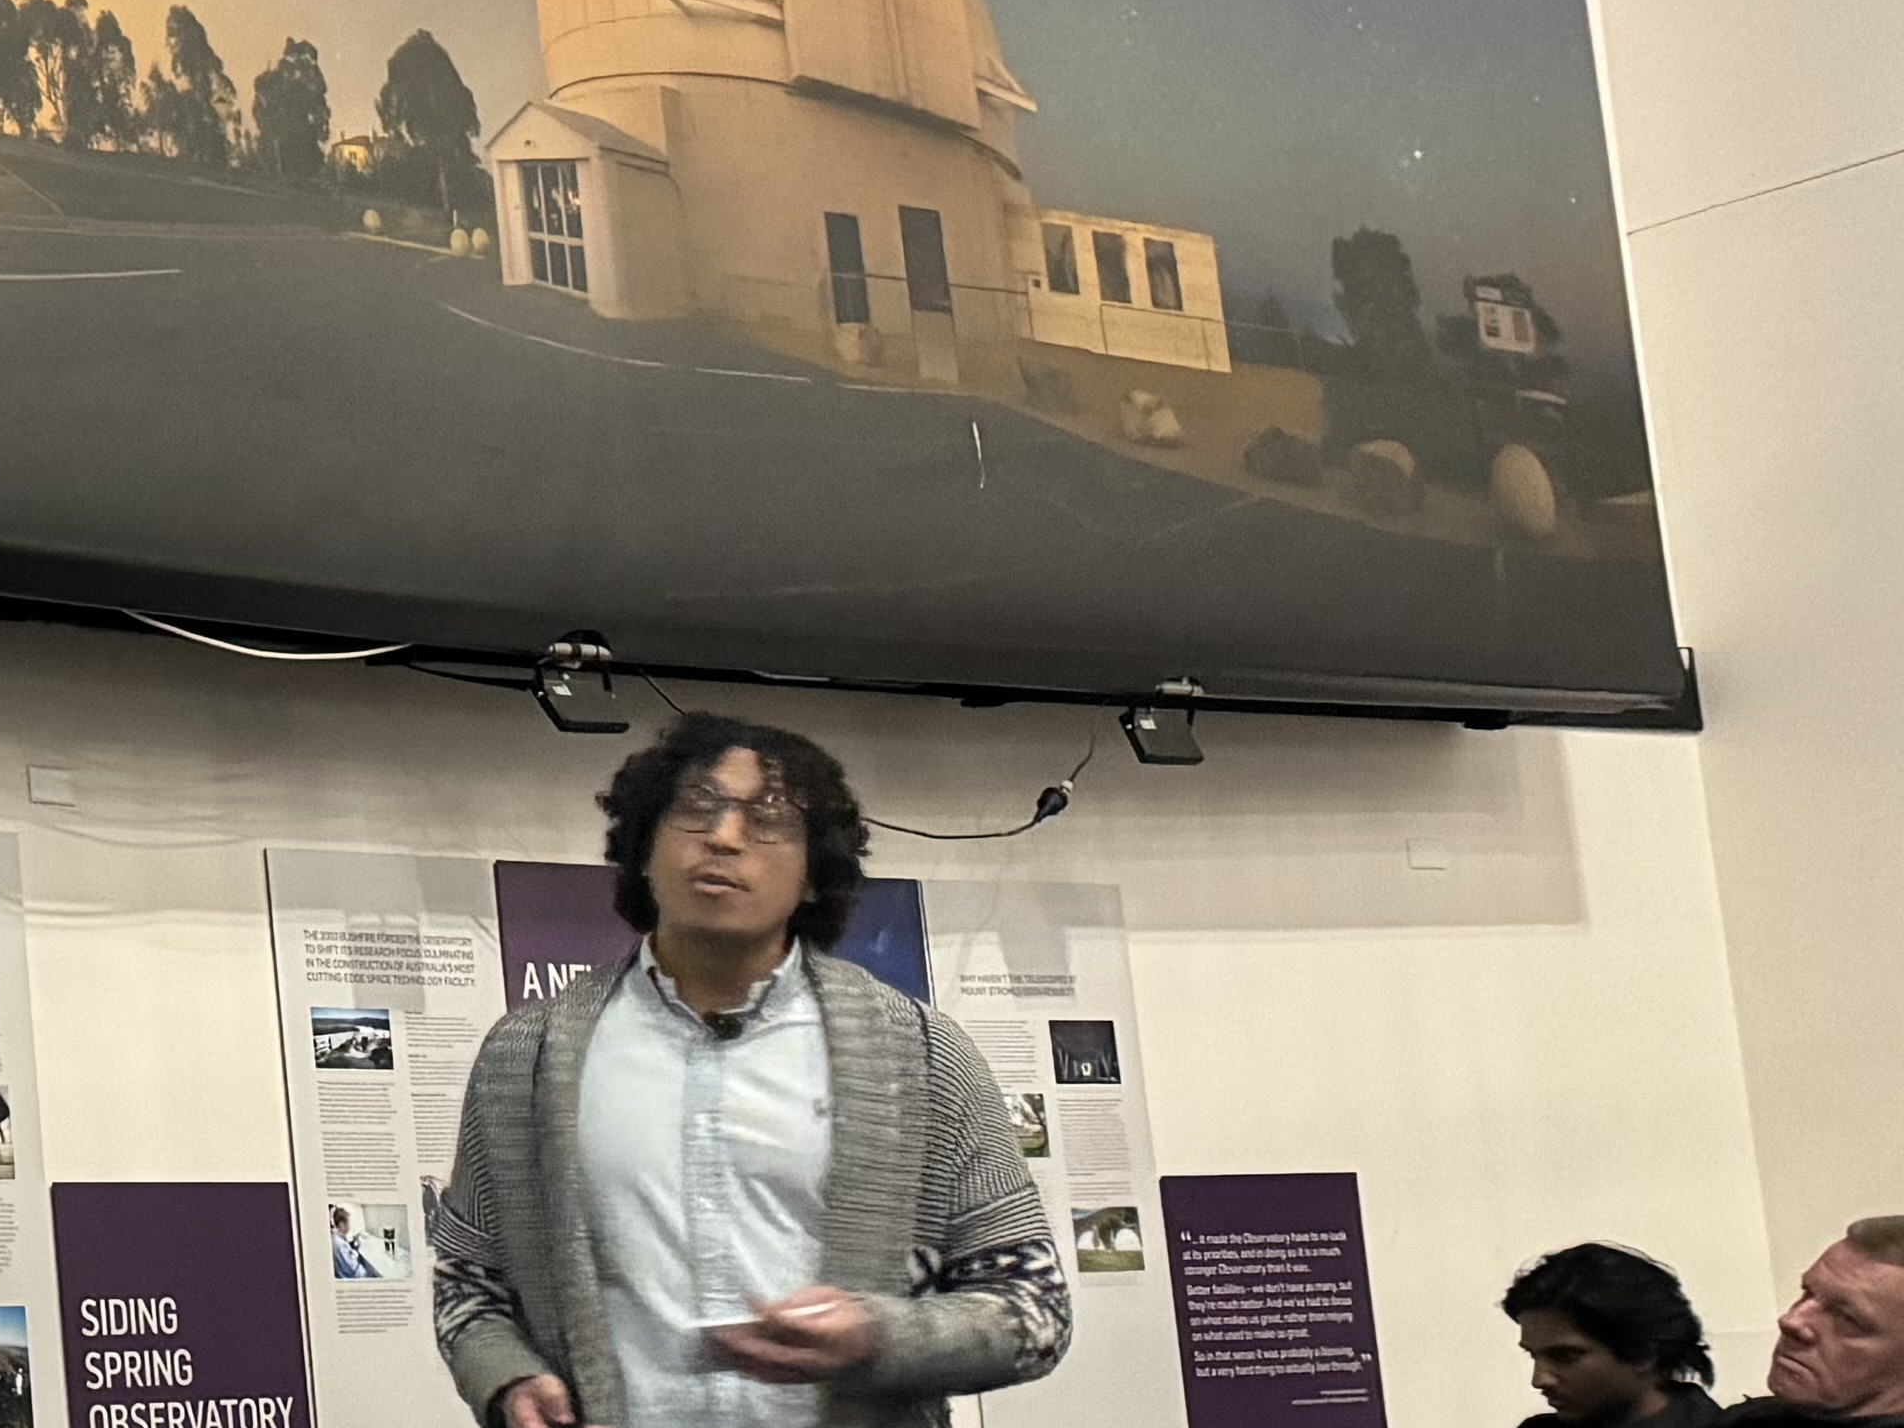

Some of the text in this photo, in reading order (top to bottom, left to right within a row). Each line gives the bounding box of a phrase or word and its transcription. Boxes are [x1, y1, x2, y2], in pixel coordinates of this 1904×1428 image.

[523, 962, 544, 1000] A
[81, 1297, 178, 1337] SIDING
[85, 1348, 193, 1390] SPRING
